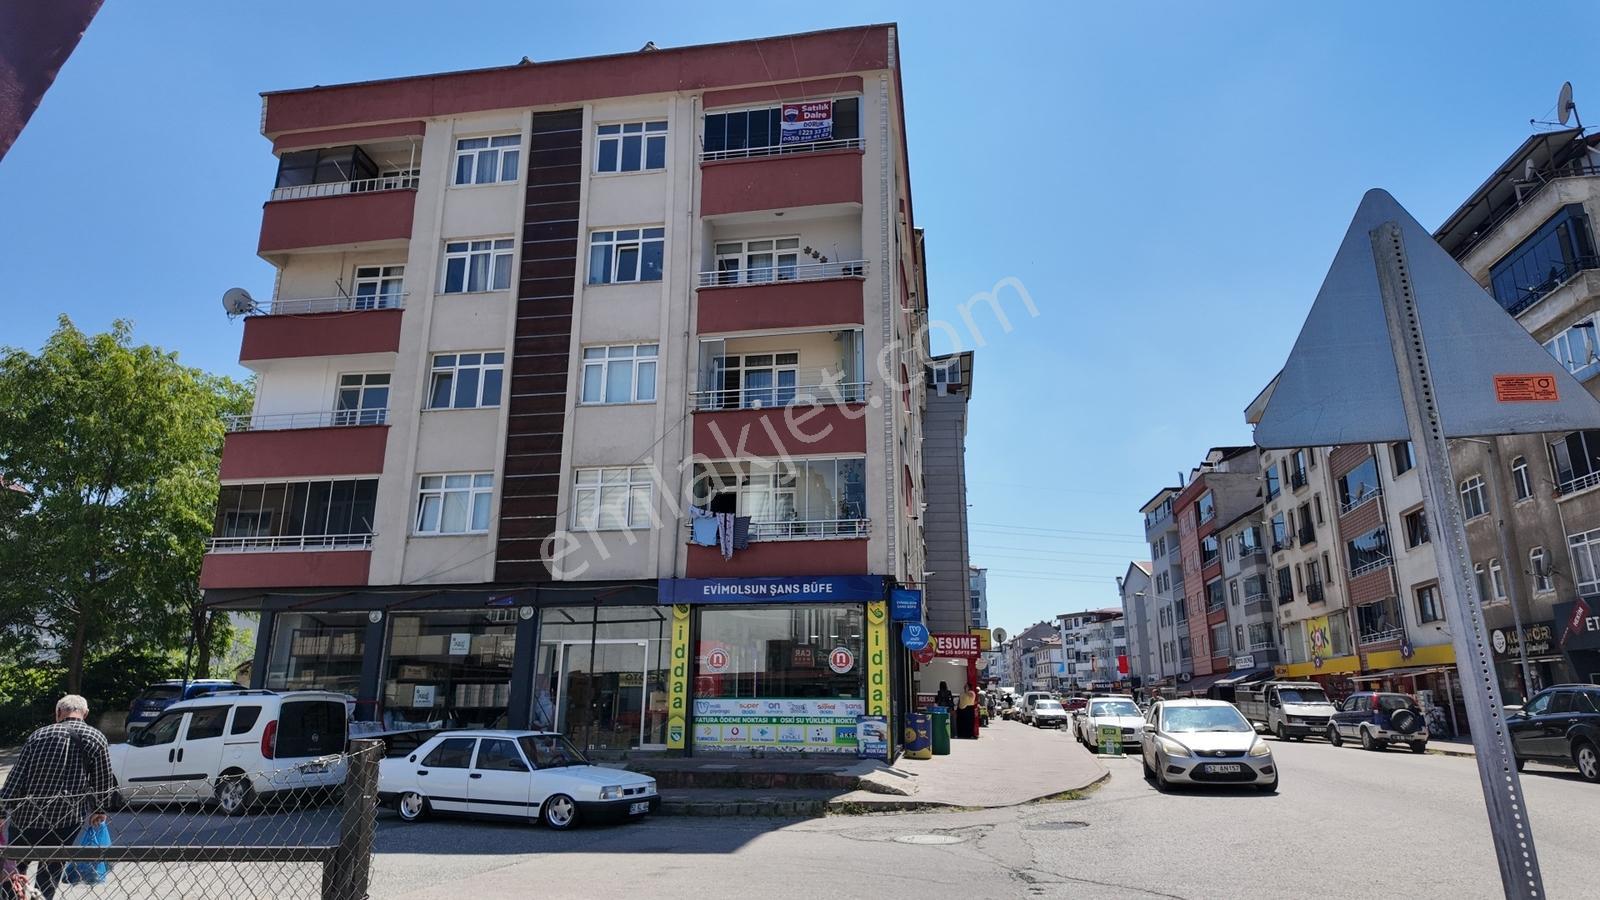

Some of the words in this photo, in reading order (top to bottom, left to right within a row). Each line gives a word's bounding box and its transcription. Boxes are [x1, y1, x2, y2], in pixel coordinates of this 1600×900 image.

[703, 583, 767, 595] EVİMOLSUN
[769, 584, 800, 597] ŞANS
[802, 581, 833, 593] BÜFE
[672, 625, 686, 709] iddaa
